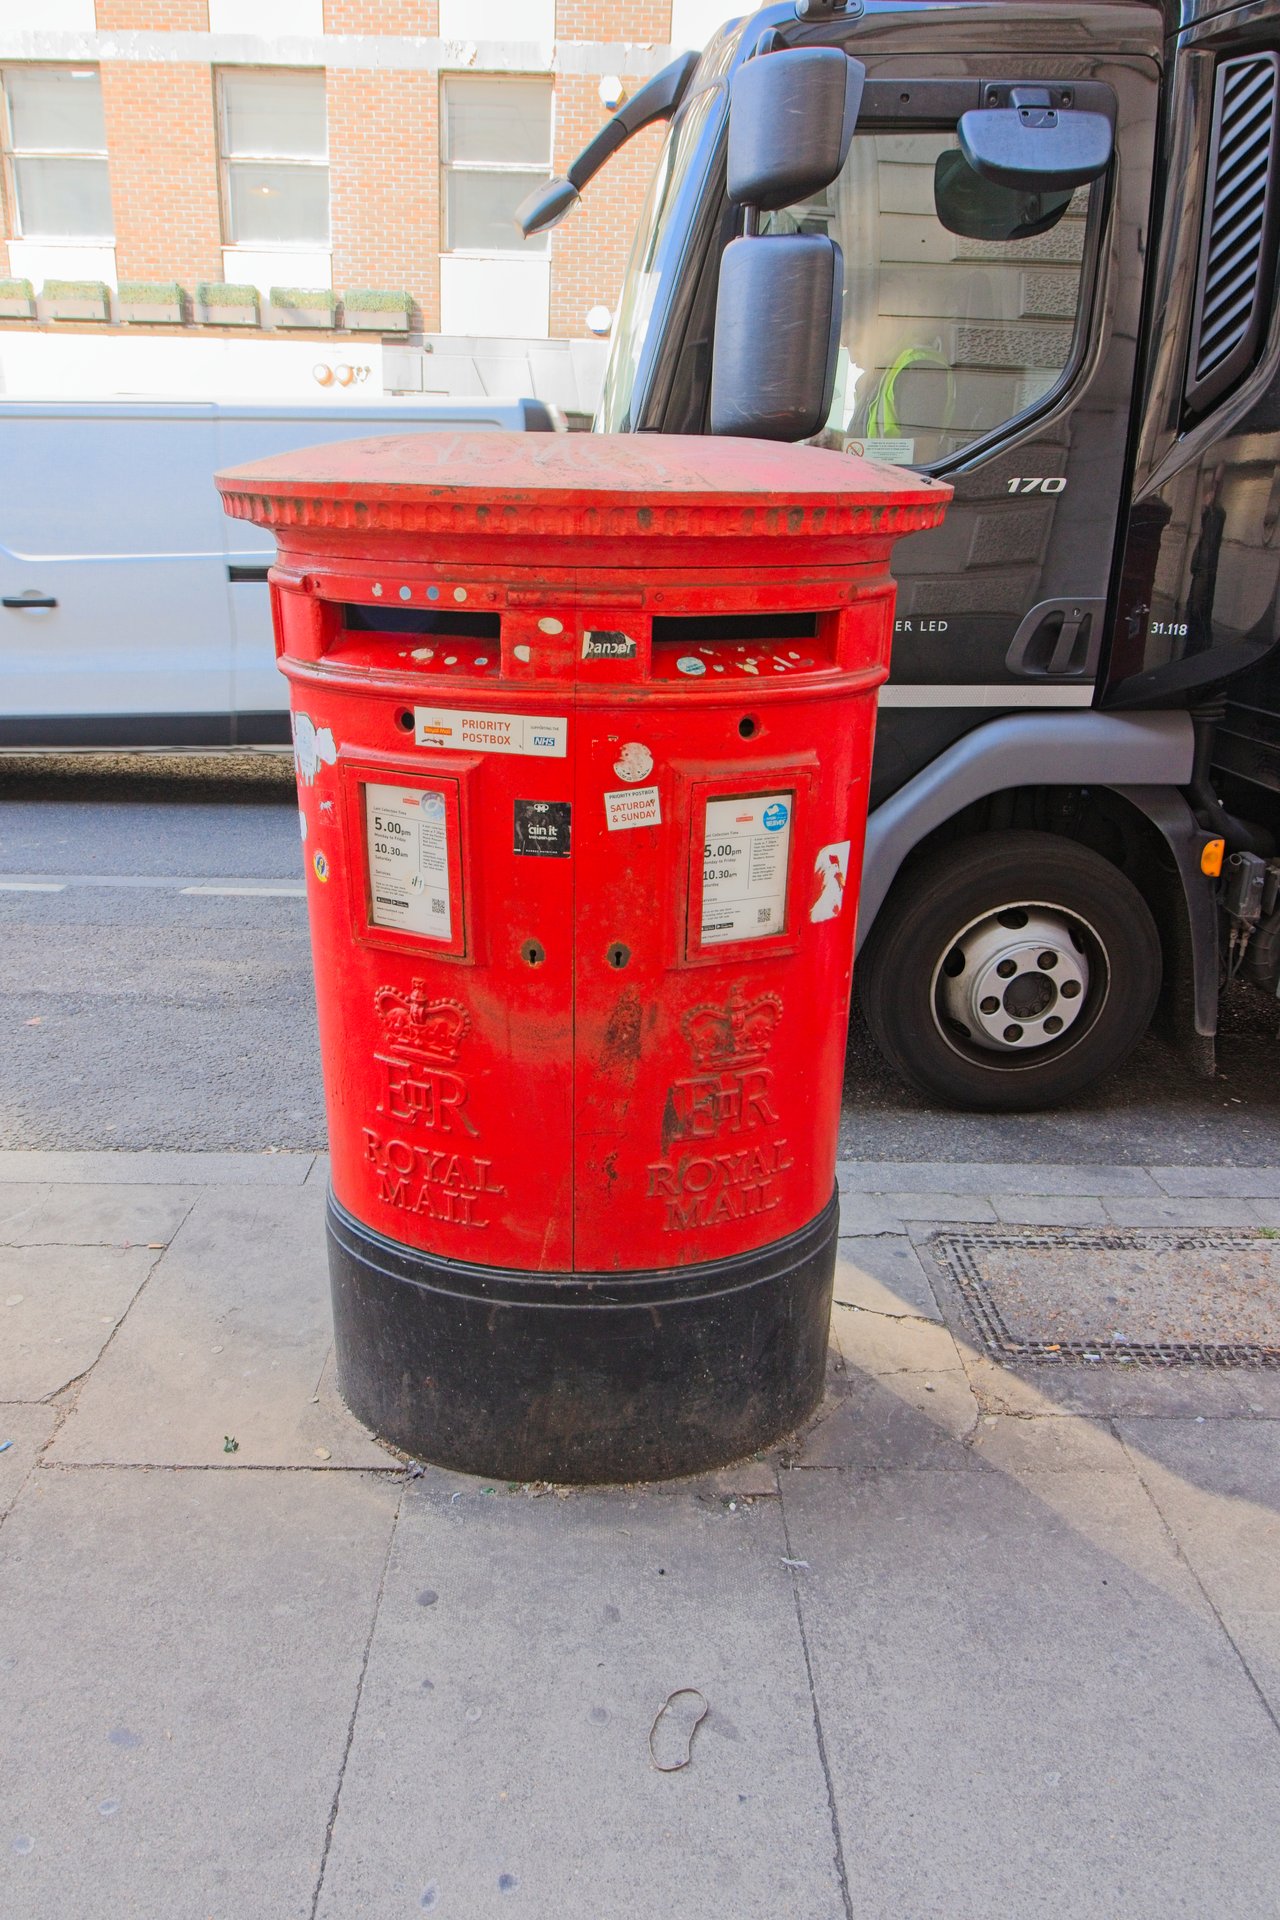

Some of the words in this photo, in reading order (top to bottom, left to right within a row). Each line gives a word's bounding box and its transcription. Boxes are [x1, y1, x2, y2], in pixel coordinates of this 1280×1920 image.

[1007, 477, 1067, 493] 170
[920, 621, 948, 632] LED
[1150, 622, 1188, 636] 31.118
[462, 719, 511, 732] PRIORITY
[462, 733, 511, 745] POSTBOX
[534, 737, 555, 746] NHS
[632, 789, 654, 797] POSTBOX
[610, 799, 656, 812] SATURDAY
[621, 810, 656, 821] SUNDAY
[362, 1126, 505, 1193] ROYAL
[645, 1139, 794, 1198] ROYAL
[377, 1168, 491, 1228] MAIL
[662, 1179, 782, 1232] MAIL
